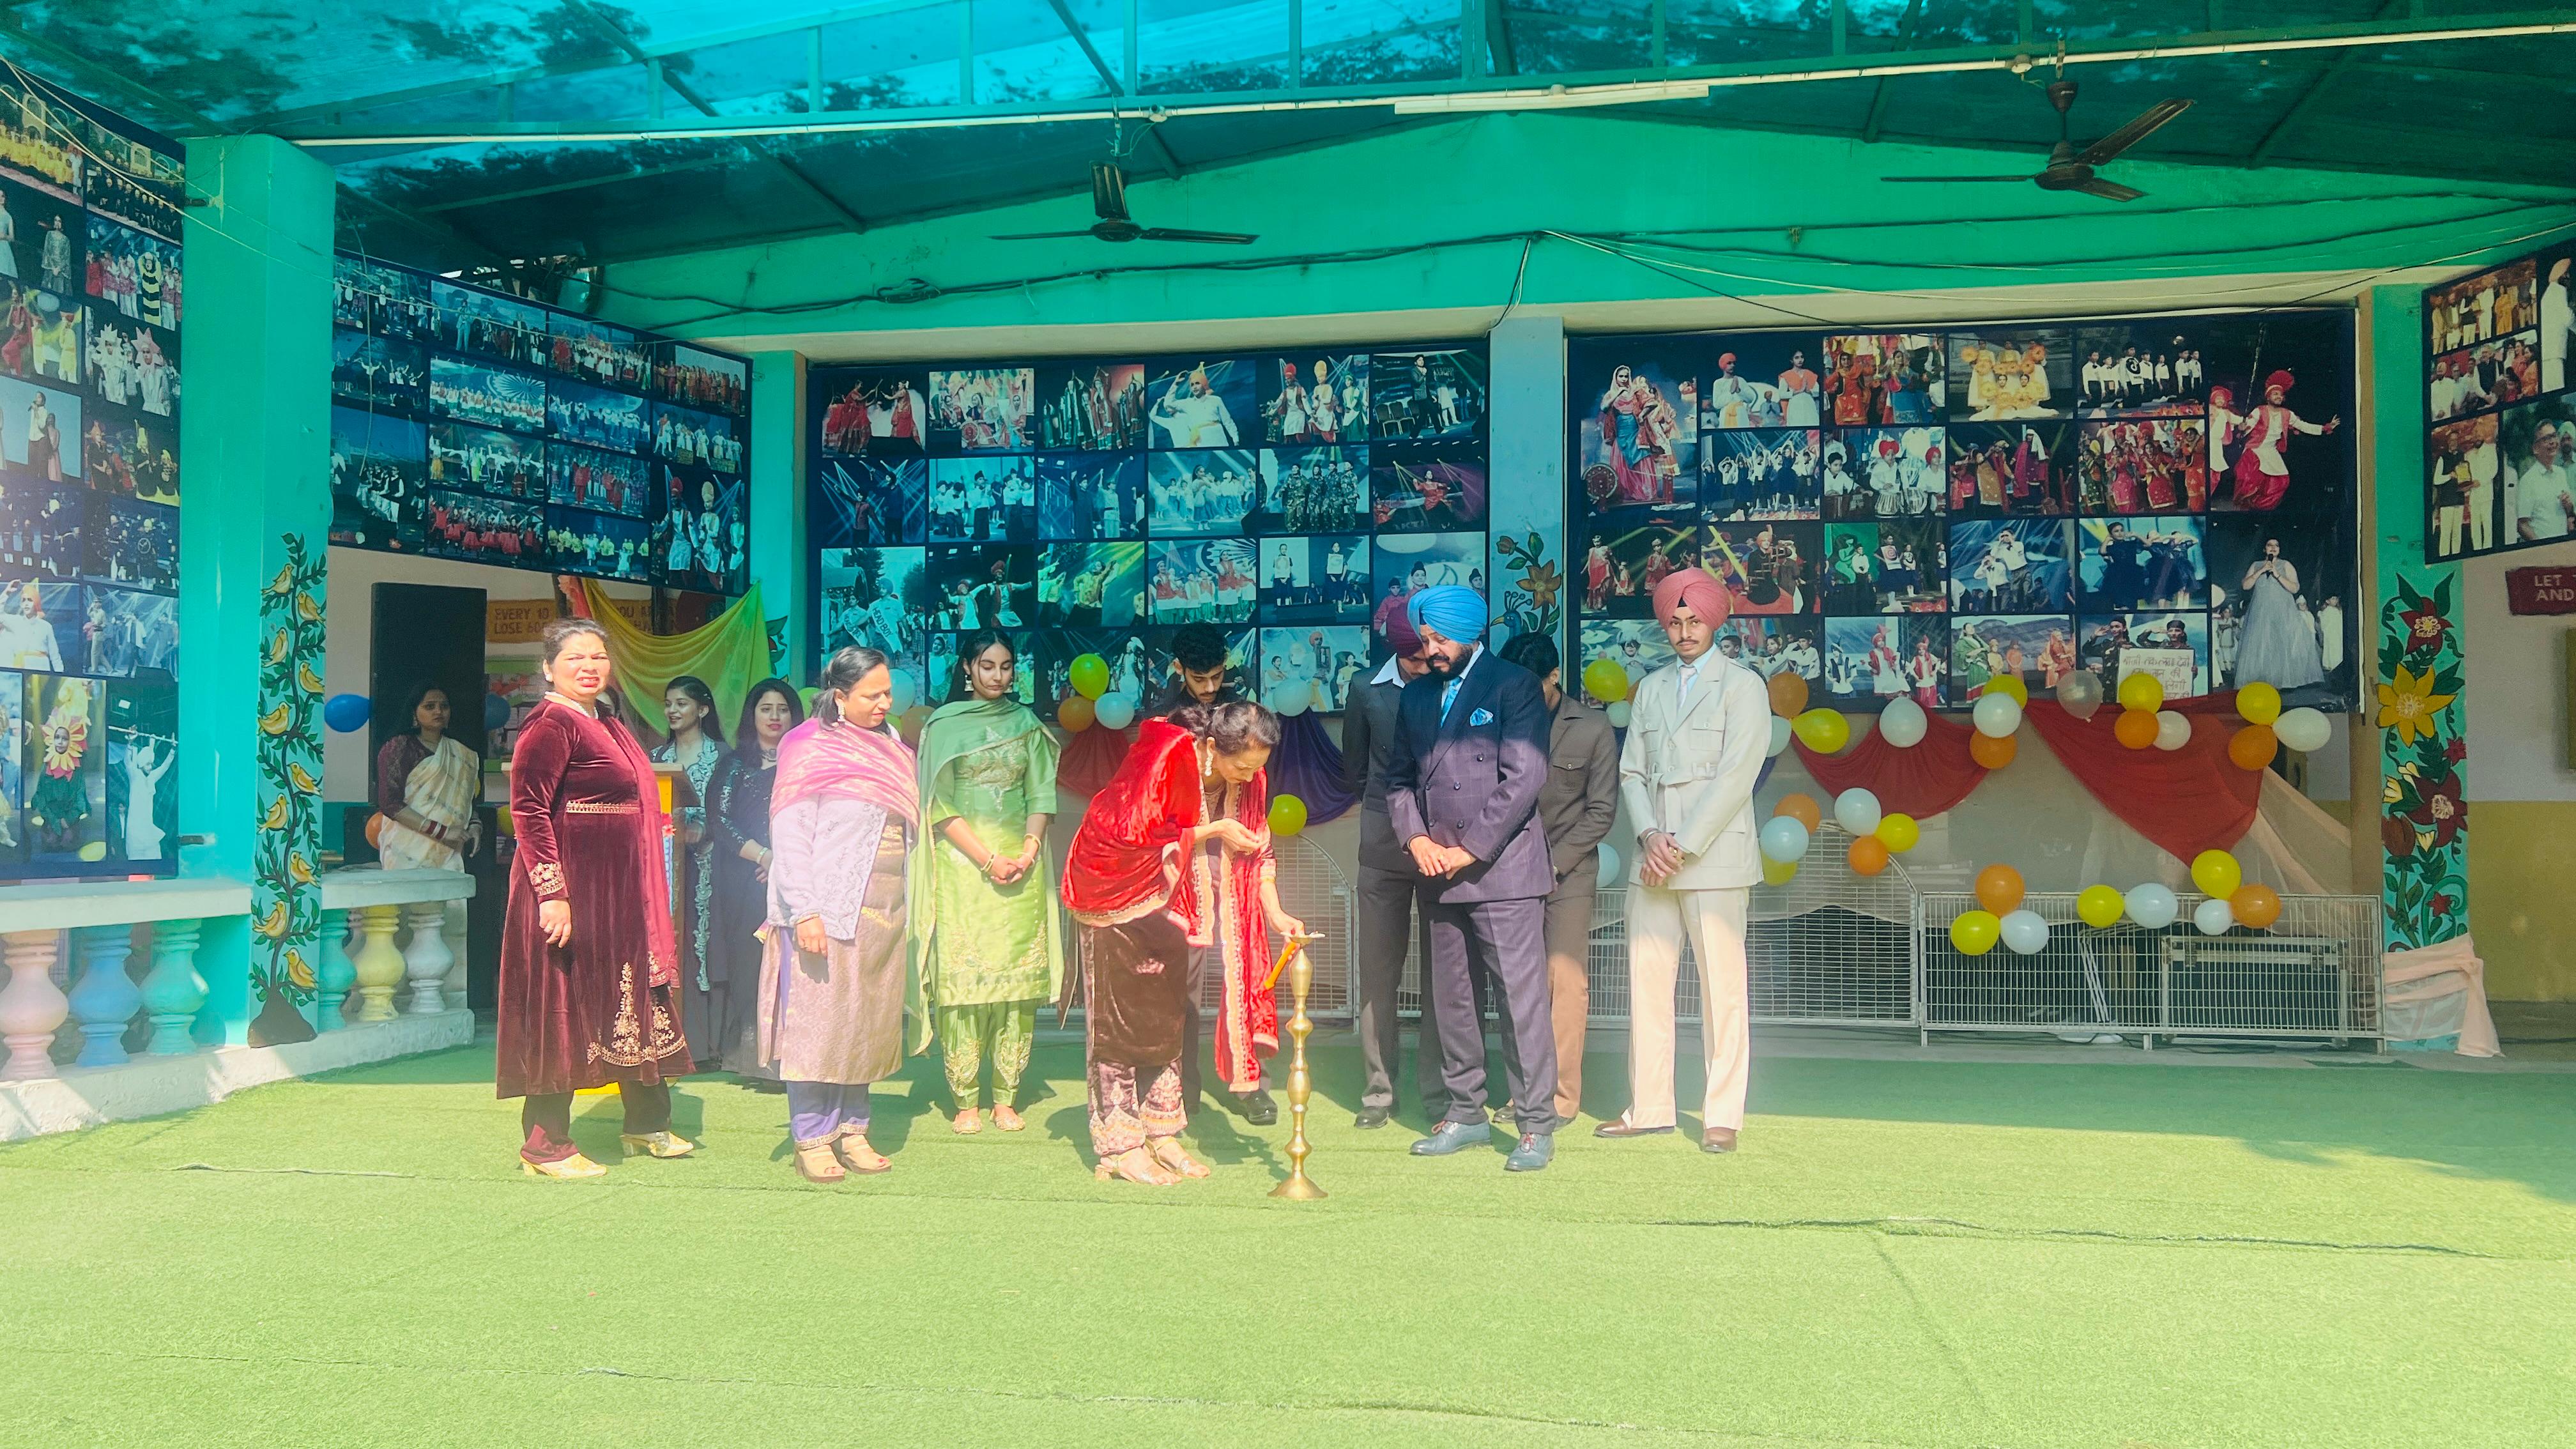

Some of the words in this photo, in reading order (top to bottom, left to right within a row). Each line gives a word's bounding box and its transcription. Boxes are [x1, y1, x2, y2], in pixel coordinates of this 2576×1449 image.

[2534, 574, 2562, 586] LET
[2534, 588, 2575, 601] AND
[494, 608, 530, 620] EVERY
[538, 608, 549, 619] 10
[494, 622, 522, 634] LOSE
[872, 606, 885, 625] HEAD
[879, 623, 894, 638] BOY
